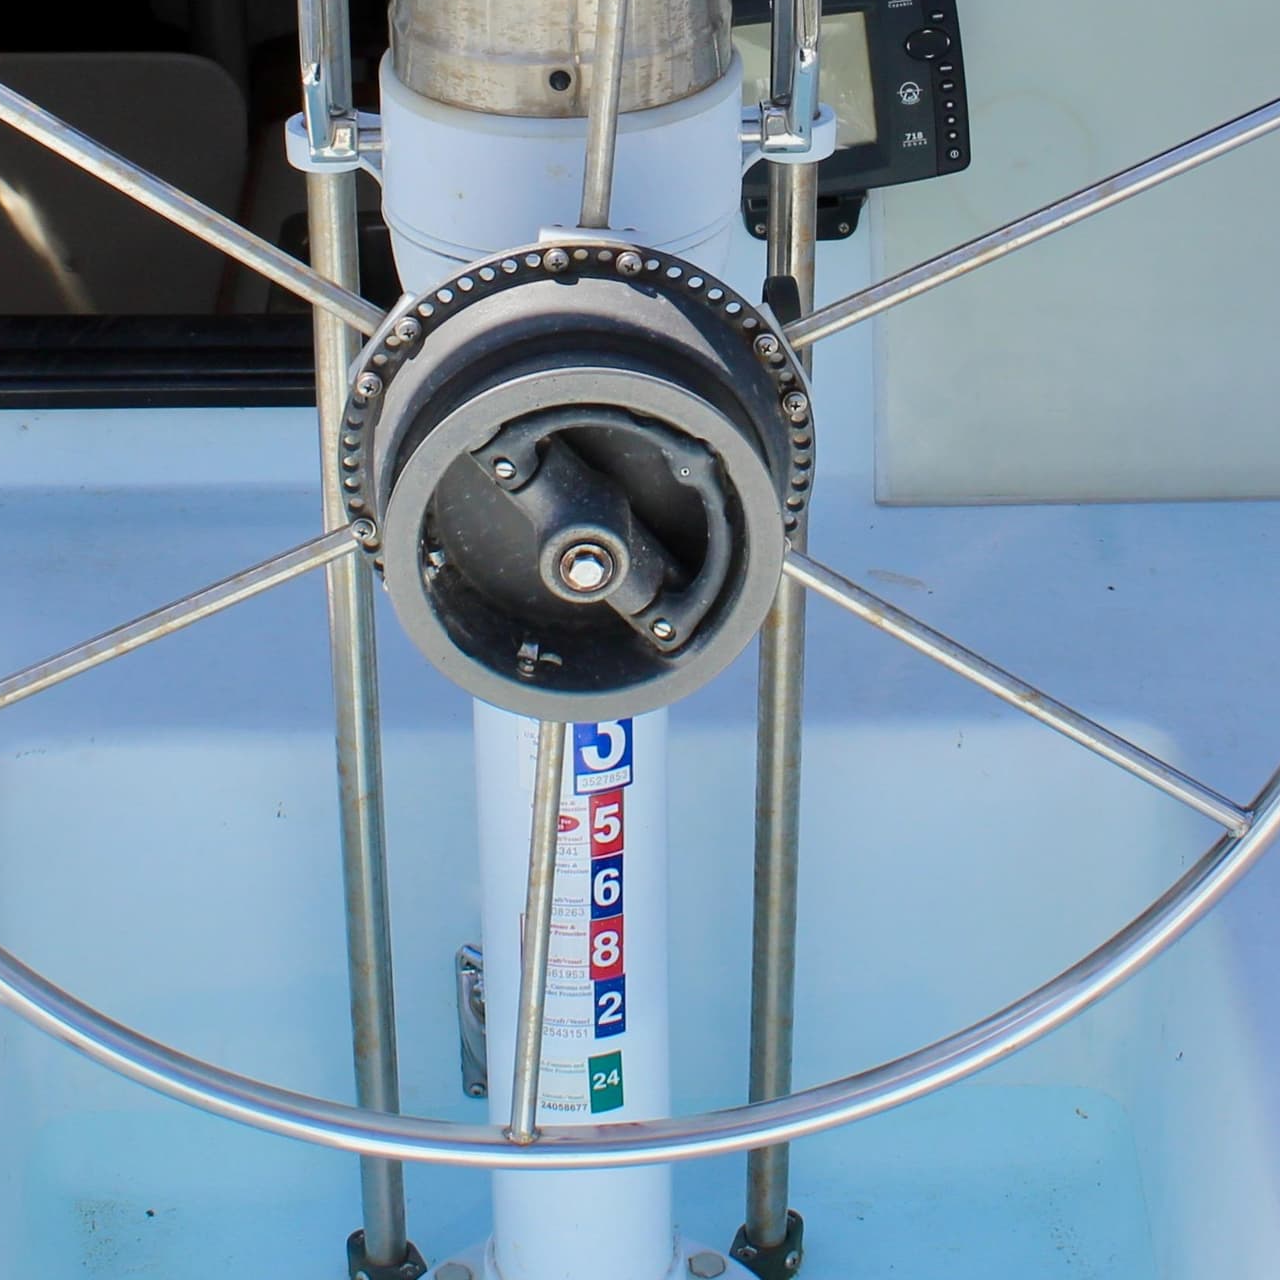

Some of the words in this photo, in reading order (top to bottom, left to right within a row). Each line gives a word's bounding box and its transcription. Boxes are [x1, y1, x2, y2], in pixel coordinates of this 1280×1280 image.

[904, 131, 924, 141] 718
[592, 803, 621, 844] 5
[593, 867, 621, 907] 6
[591, 930, 620, 968] 8
[598, 991, 623, 1026] 2
[543, 1026, 589, 1039] 2543151
[592, 1067, 620, 1091] 24
